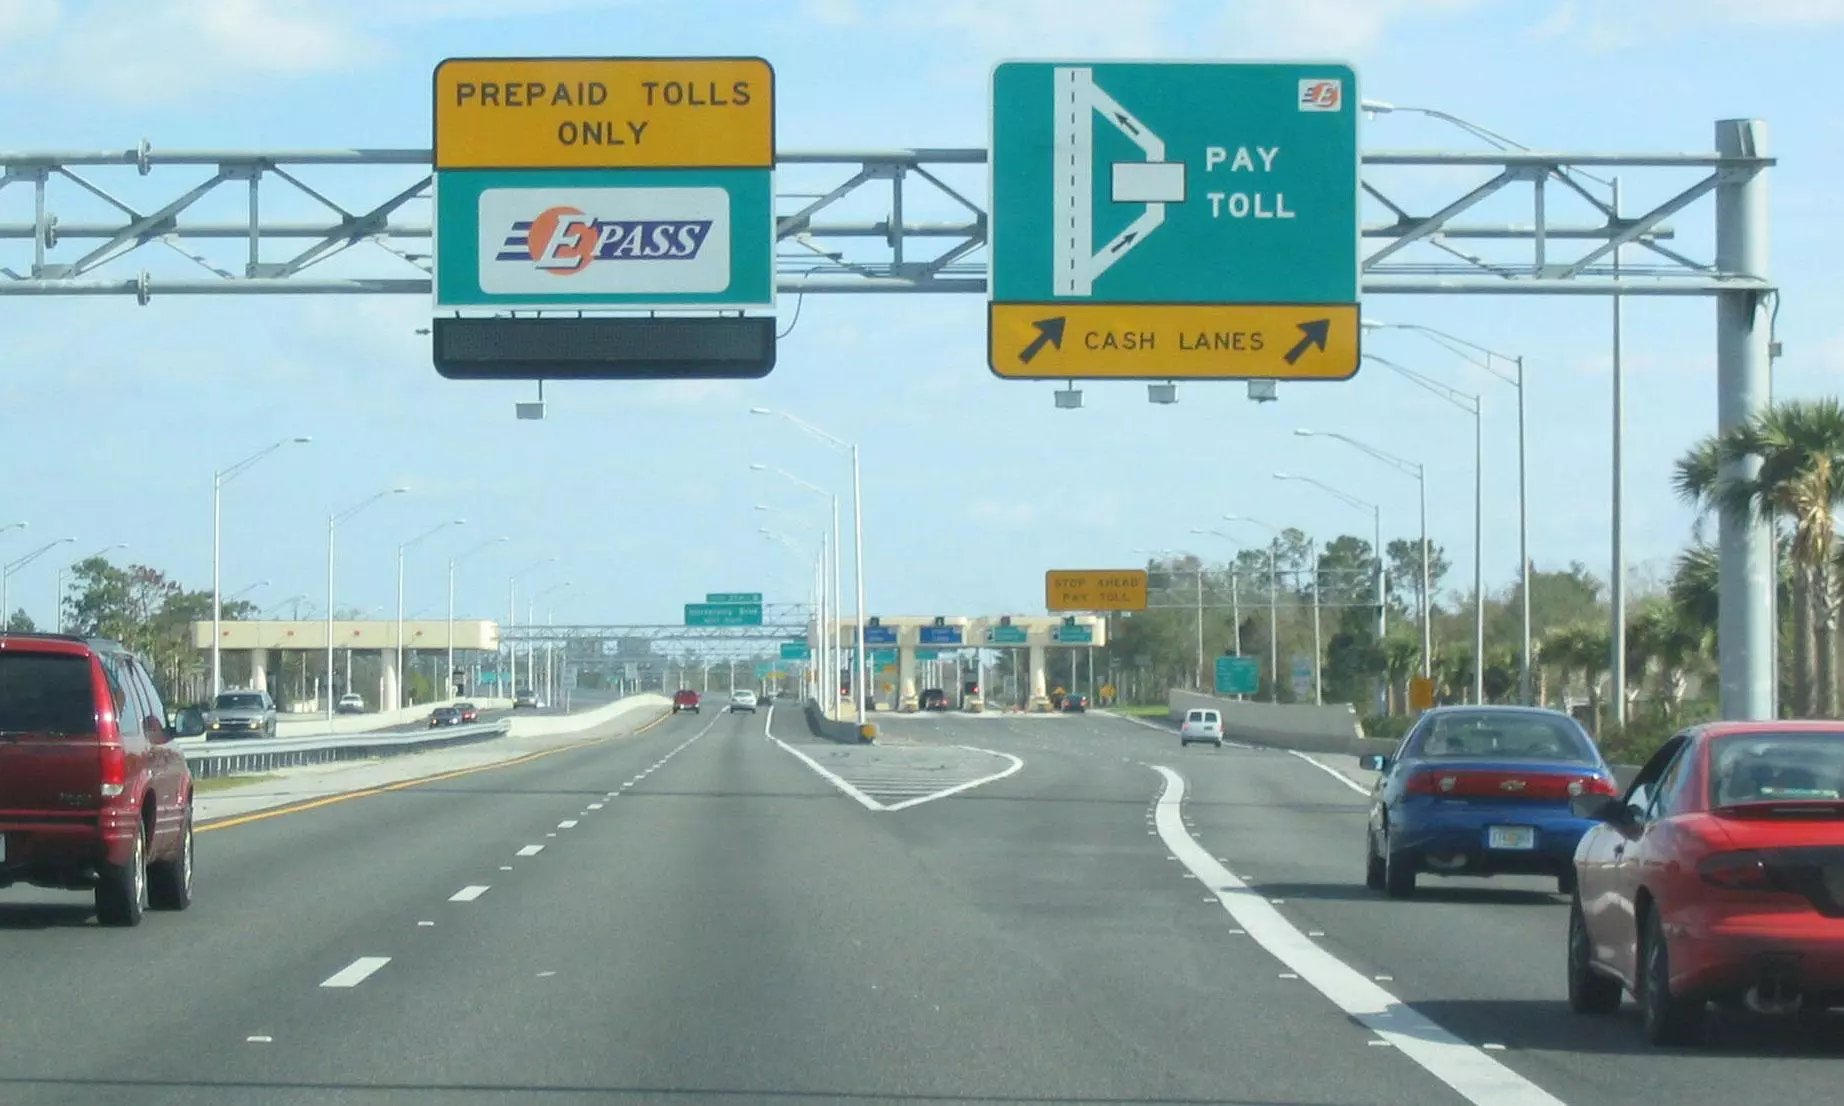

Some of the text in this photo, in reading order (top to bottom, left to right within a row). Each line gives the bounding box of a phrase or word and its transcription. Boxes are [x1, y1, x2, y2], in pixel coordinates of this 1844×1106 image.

[456, 81, 751, 107] PREPAID TOLLS
[558, 120, 648, 146] ONLY
[1205, 145, 1280, 172] PAY
[1206, 191, 1296, 219] TOLL
[1084, 331, 1265, 351] CASH LANES
[1055, 577, 1140, 588] STOP AHEAD
[1062, 592, 1130, 602] PAY TOLL
